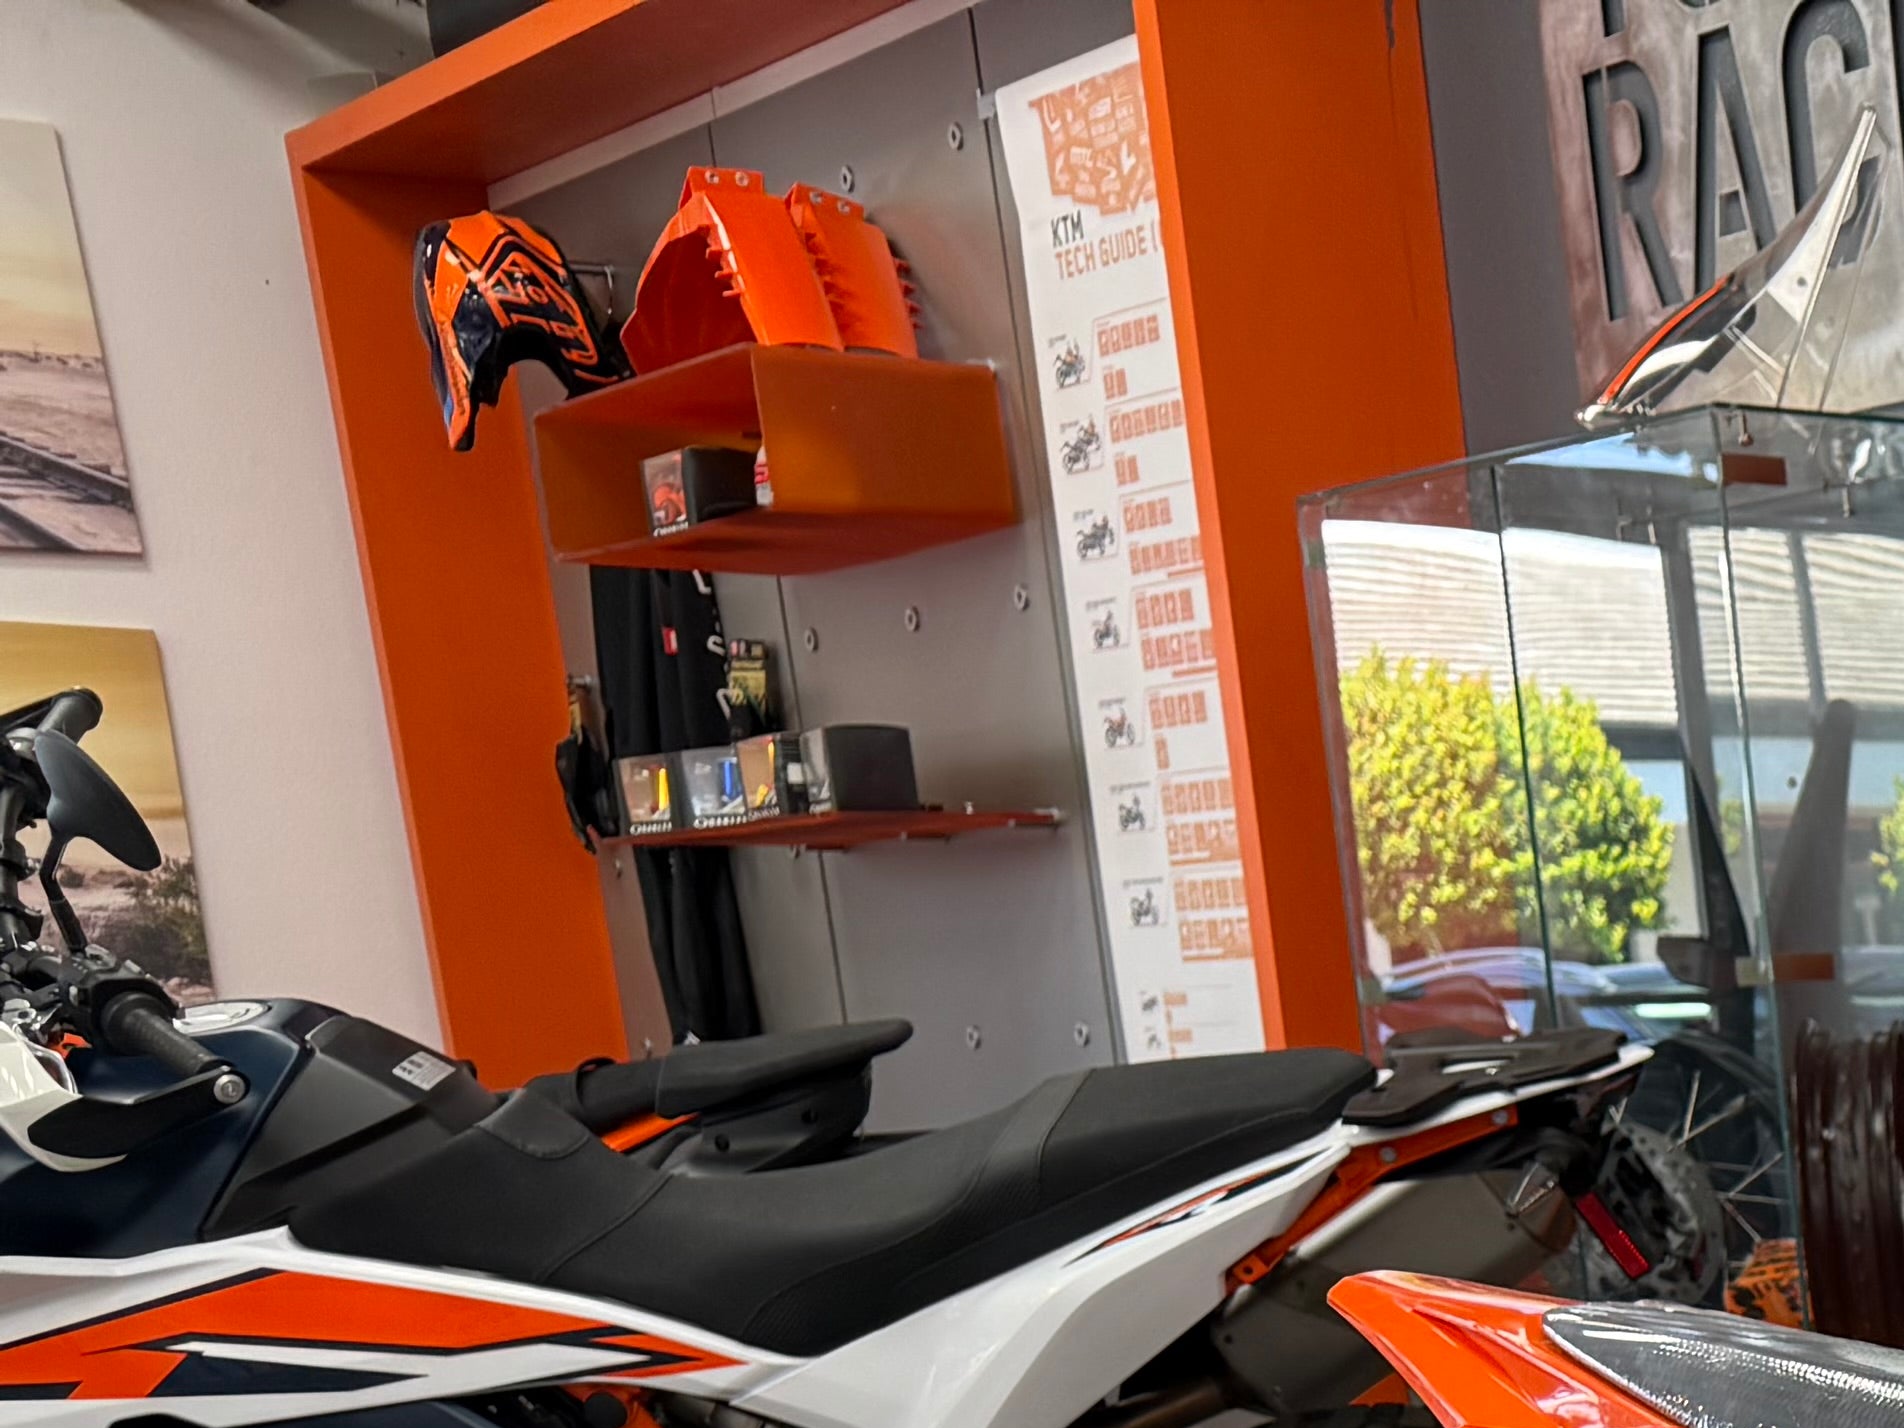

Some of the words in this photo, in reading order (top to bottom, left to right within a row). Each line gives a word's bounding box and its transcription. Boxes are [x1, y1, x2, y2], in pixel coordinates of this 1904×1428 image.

[1050, 208, 1086, 249] KTM
[1053, 241, 1096, 281] TECH
[1099, 227, 1149, 269] GUIDE
